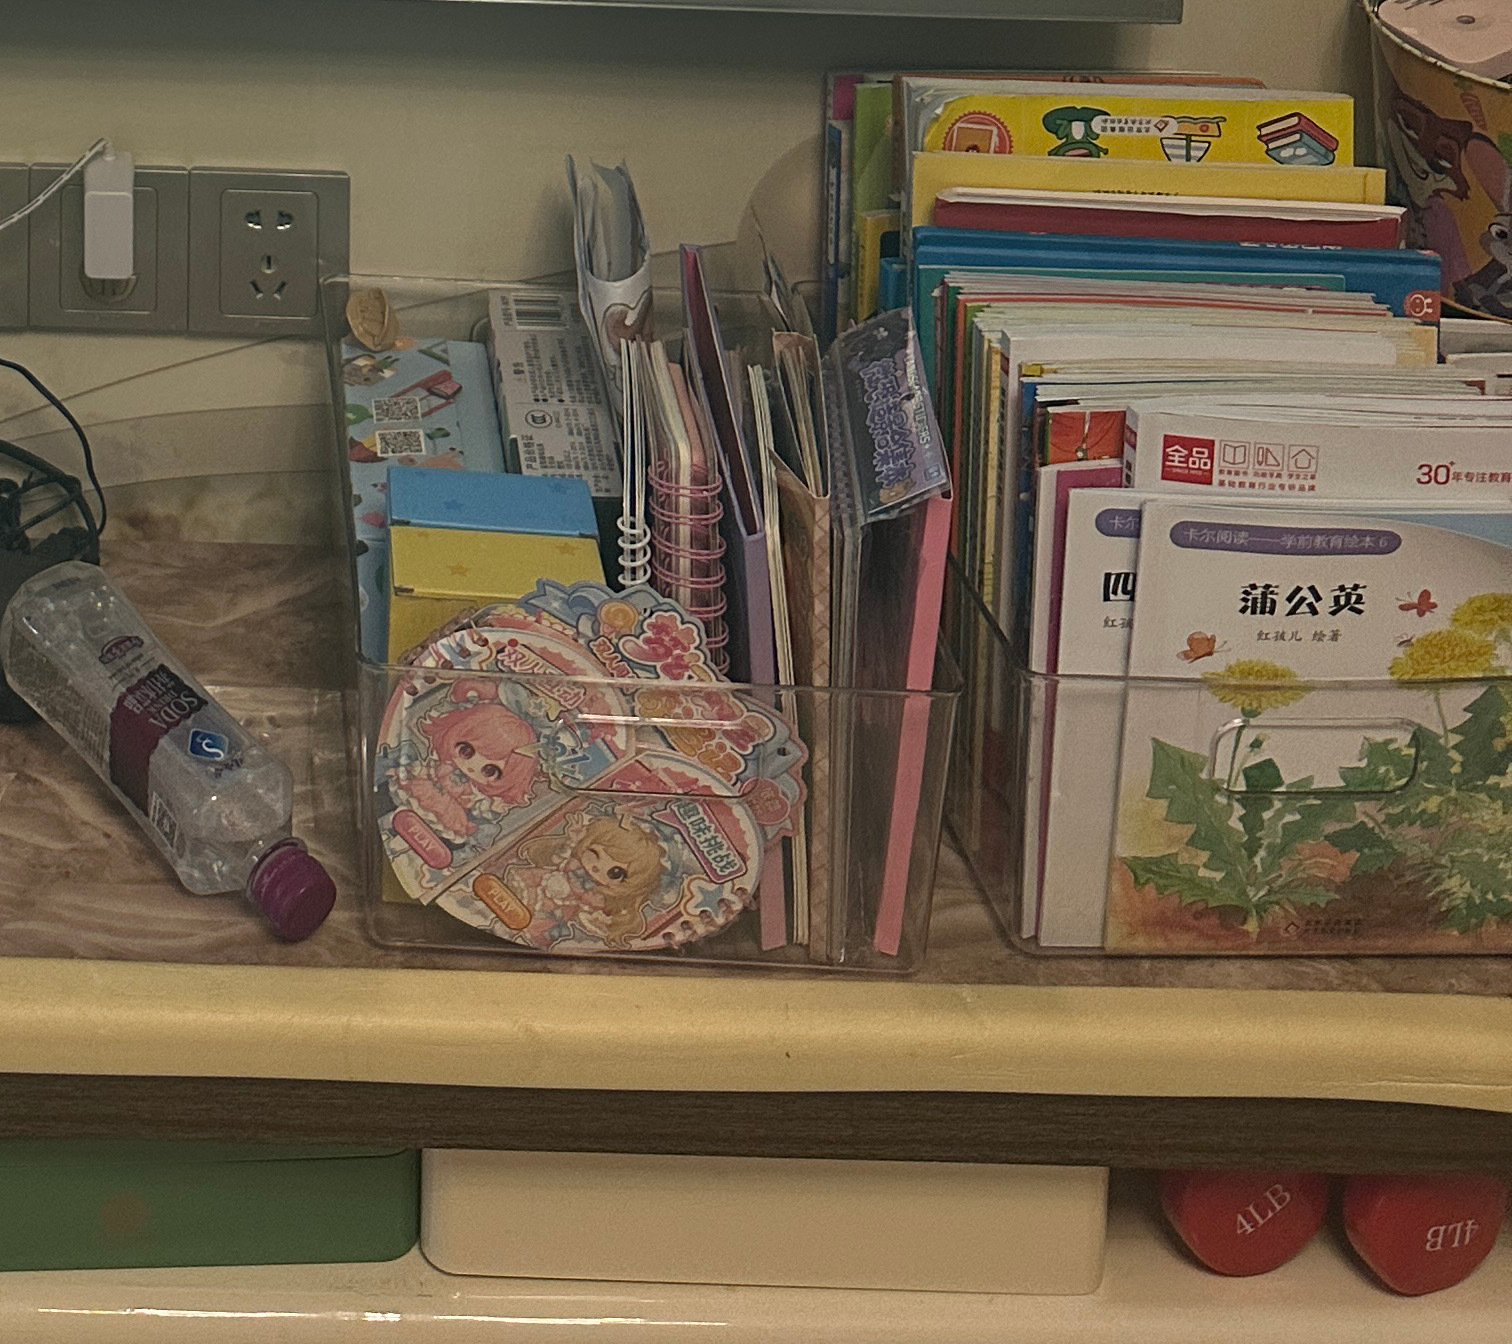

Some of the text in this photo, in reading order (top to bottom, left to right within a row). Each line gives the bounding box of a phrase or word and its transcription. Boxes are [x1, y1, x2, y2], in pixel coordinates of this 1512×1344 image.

[1165, 445, 1211, 470] 全品
[1239, 583, 1367, 616] 蒲公英
[1256, 629, 1303, 642] 红孩儿
[149, 691, 199, 730] SODA
[407, 824, 437, 851] PLAY
[488, 888, 512, 913] PLAY
[1234, 1183, 1293, 1237] 4LB
[1425, 1219, 1480, 1252] 4LB
